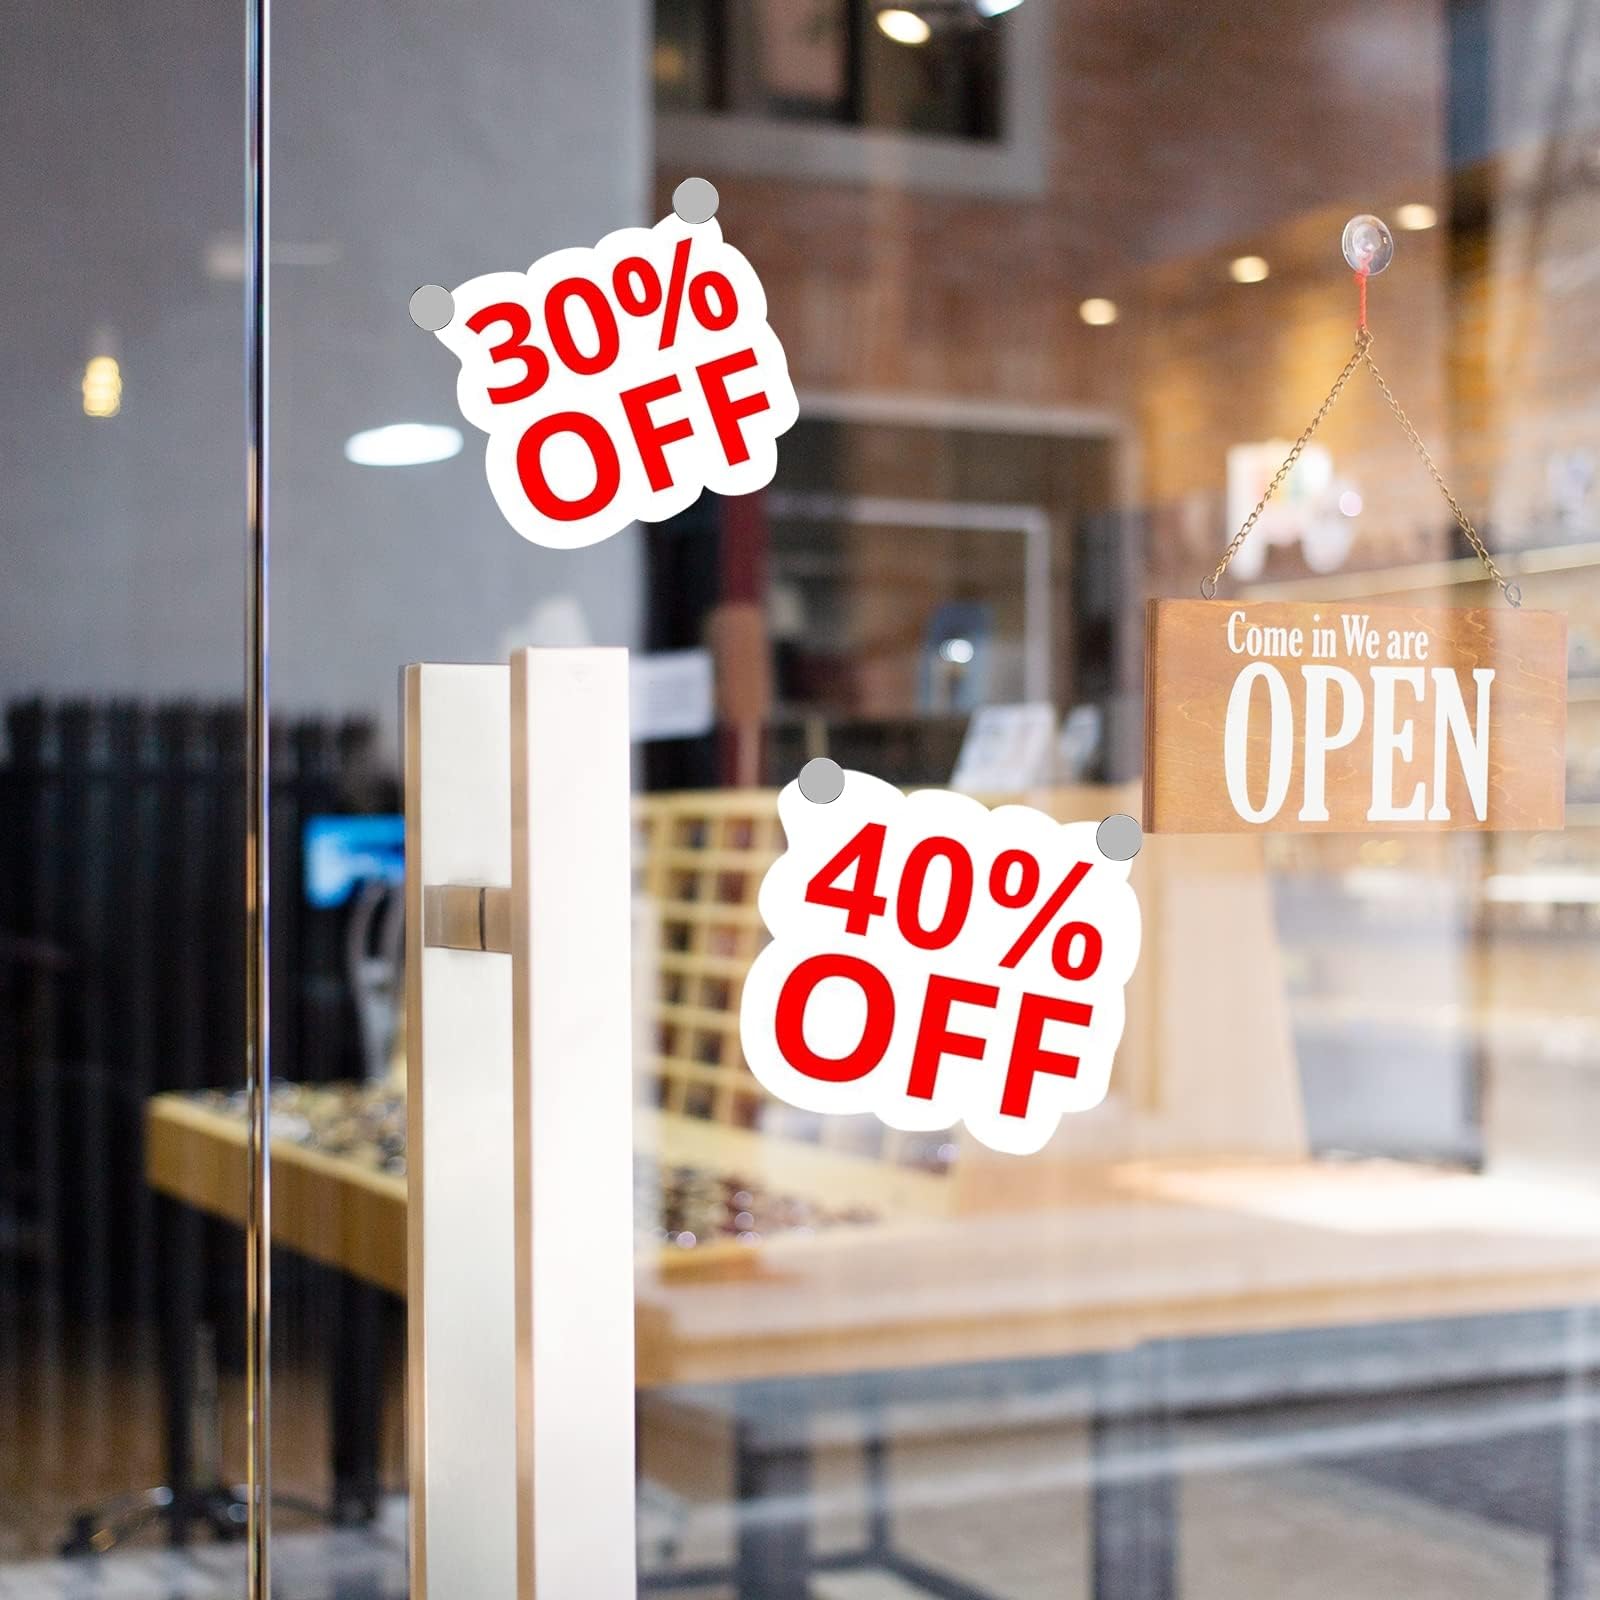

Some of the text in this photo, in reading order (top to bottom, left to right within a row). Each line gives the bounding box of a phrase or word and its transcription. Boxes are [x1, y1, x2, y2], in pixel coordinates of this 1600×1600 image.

[467, 239, 738, 404] 30%
[517, 348, 770, 521] OFF
[1227, 610, 1430, 661] Come in We are
[1223, 660, 1497, 825] OPEN
[804, 822, 1104, 982] 40%
[775, 954, 1092, 1118] OFF
